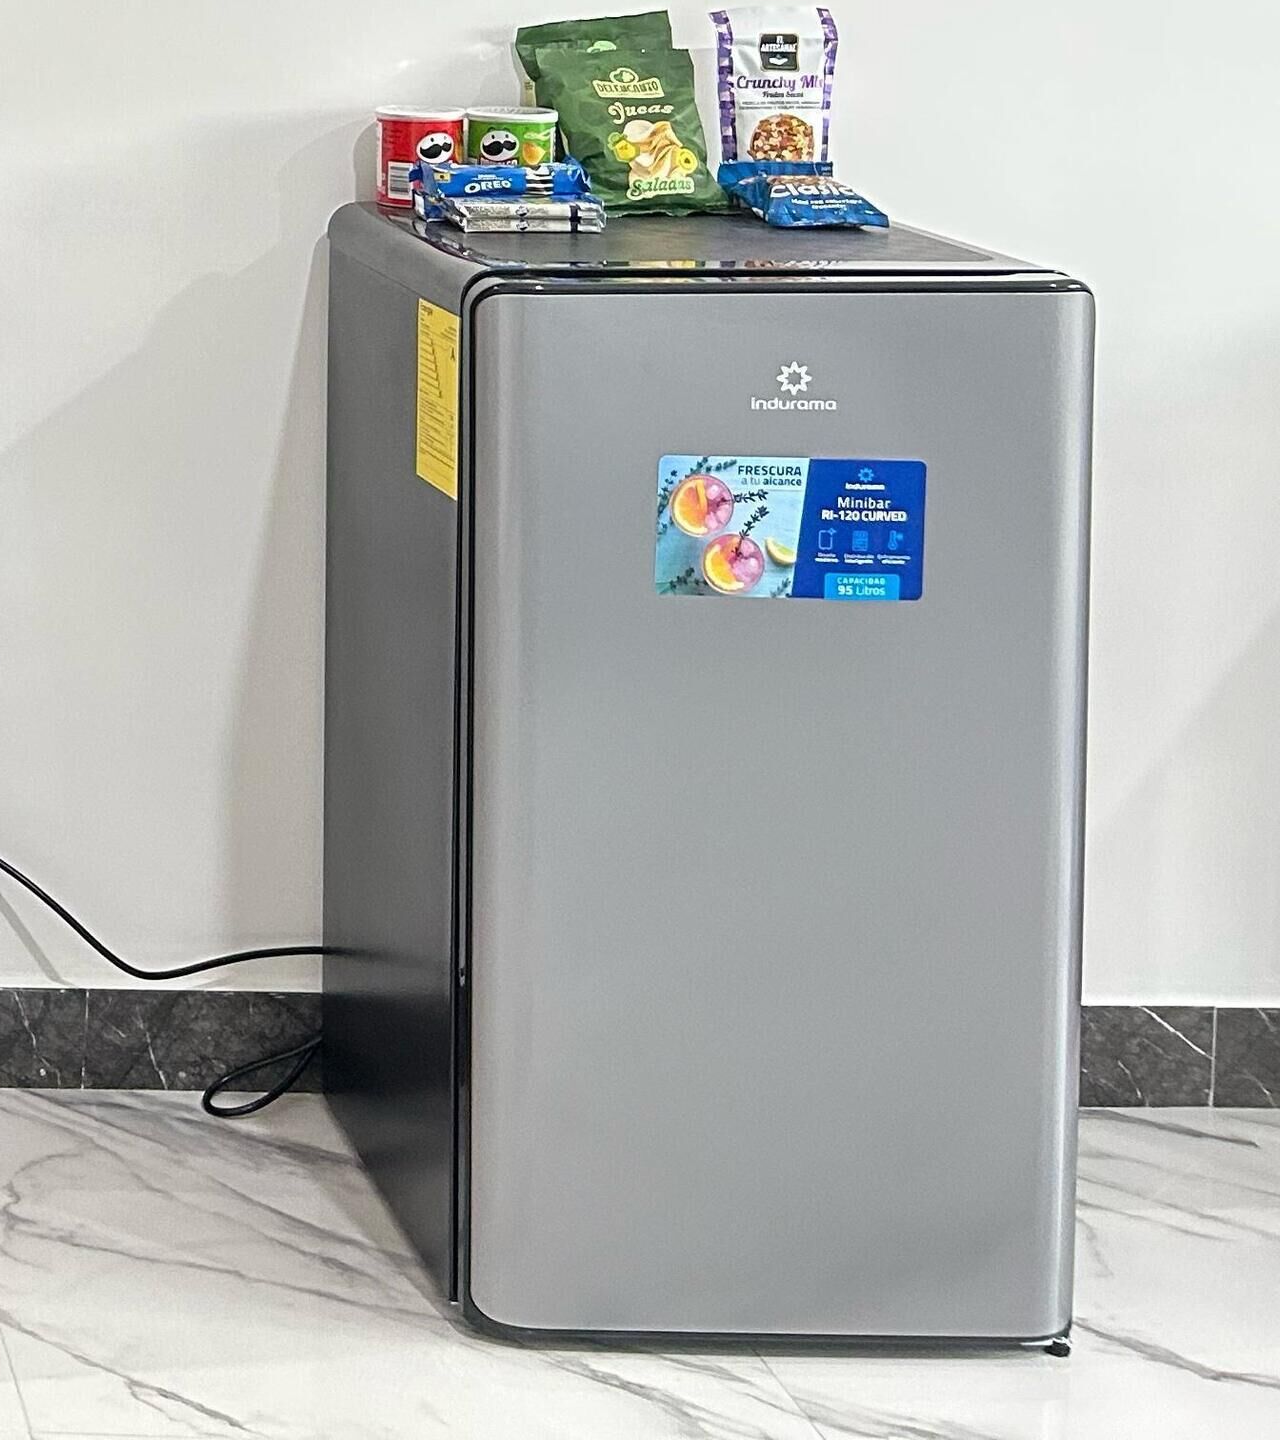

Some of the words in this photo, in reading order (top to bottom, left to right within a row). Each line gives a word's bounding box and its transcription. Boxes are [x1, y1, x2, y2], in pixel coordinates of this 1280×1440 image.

[737, 75, 796, 92] Crunchy
[608, 101, 674, 124] Yucas
[464, 180, 512, 193] OREO
[631, 177, 692, 197] Saladas
[751, 397, 837, 410] indurama
[738, 465, 802, 476] FRESCURA
[750, 477, 760, 485] tu
[762, 476, 802, 486] alcance
[837, 497, 891, 509] Minibar
[821, 509, 860, 521] RI-120
[861, 510, 908, 522] CURVED
[837, 577, 886, 585] CAPACIDAD
[838, 586, 853, 595] 95
[855, 586, 886, 596] Litros
